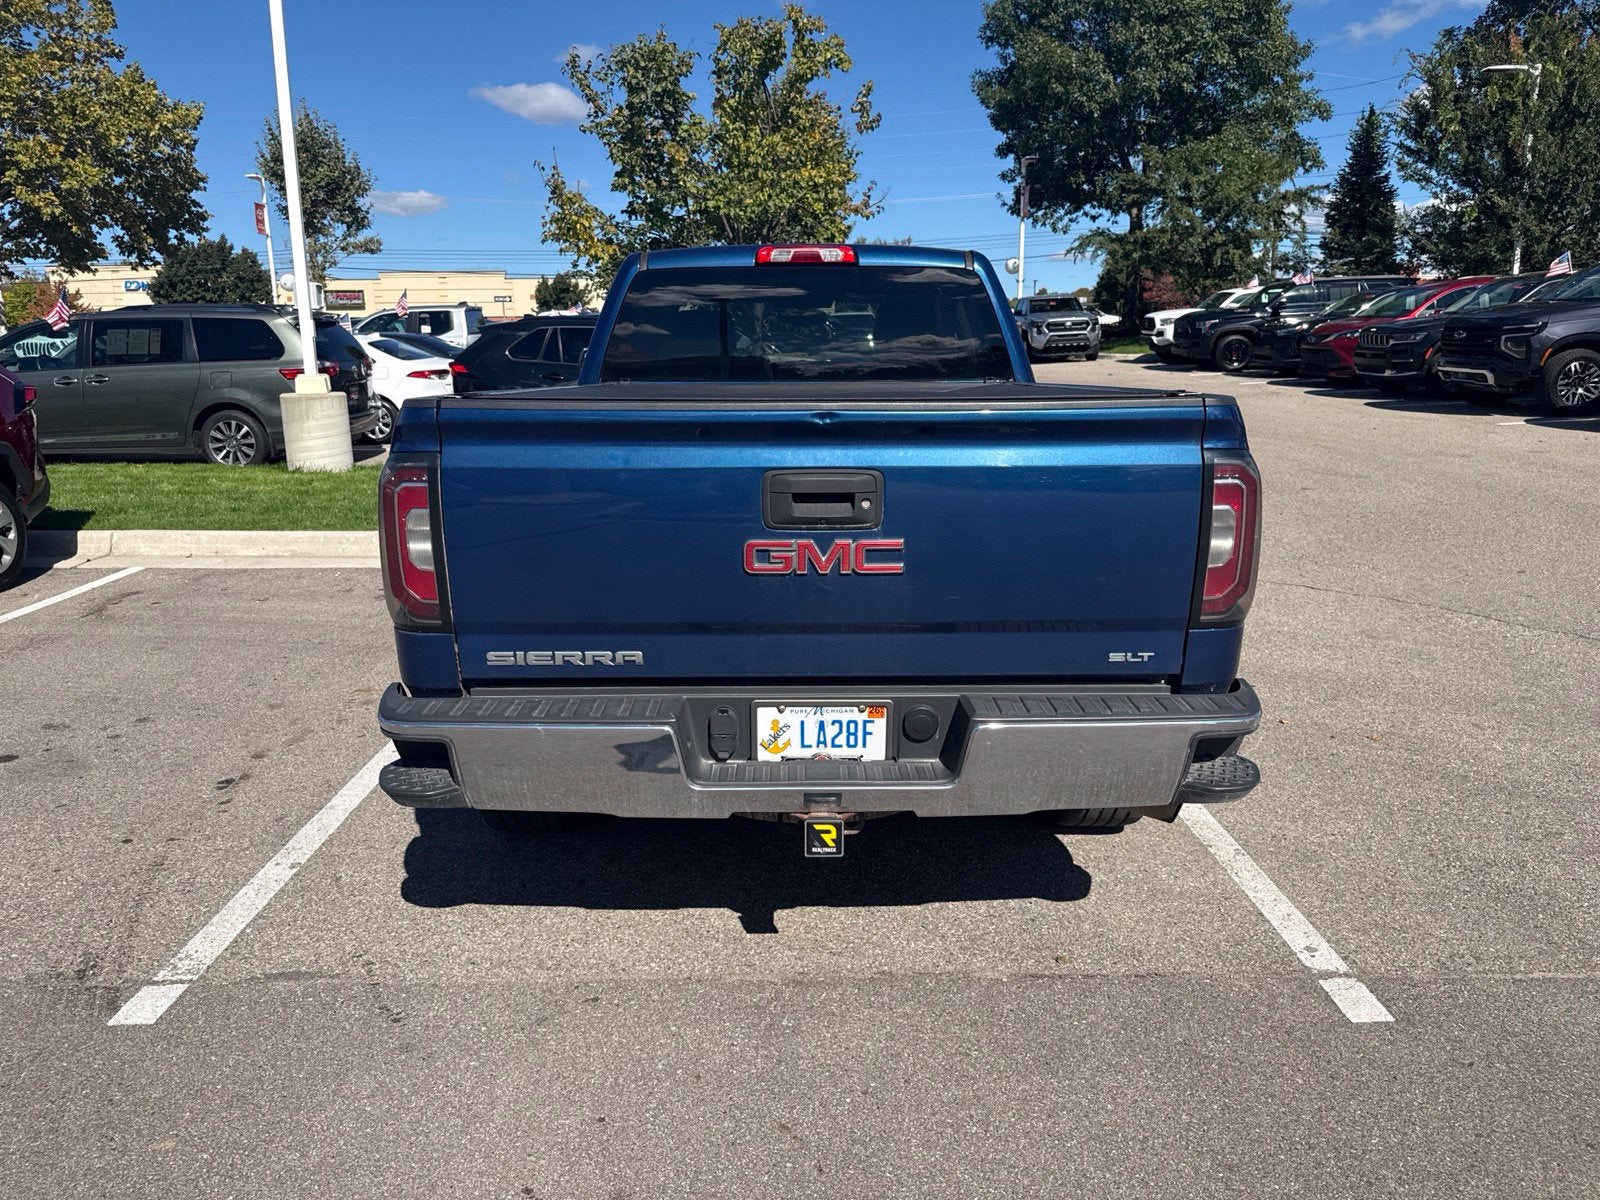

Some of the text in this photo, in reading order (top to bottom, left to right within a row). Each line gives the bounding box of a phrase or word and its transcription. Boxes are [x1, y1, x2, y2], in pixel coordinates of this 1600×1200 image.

[743, 539, 905, 575] GMC
[486, 651, 645, 666] SIERRA
[1108, 652, 1155, 662] SLT
[806, 706, 855, 718] MICHIGAN
[759, 722, 791, 750] Lakers
[800, 719, 875, 749] LA28F
